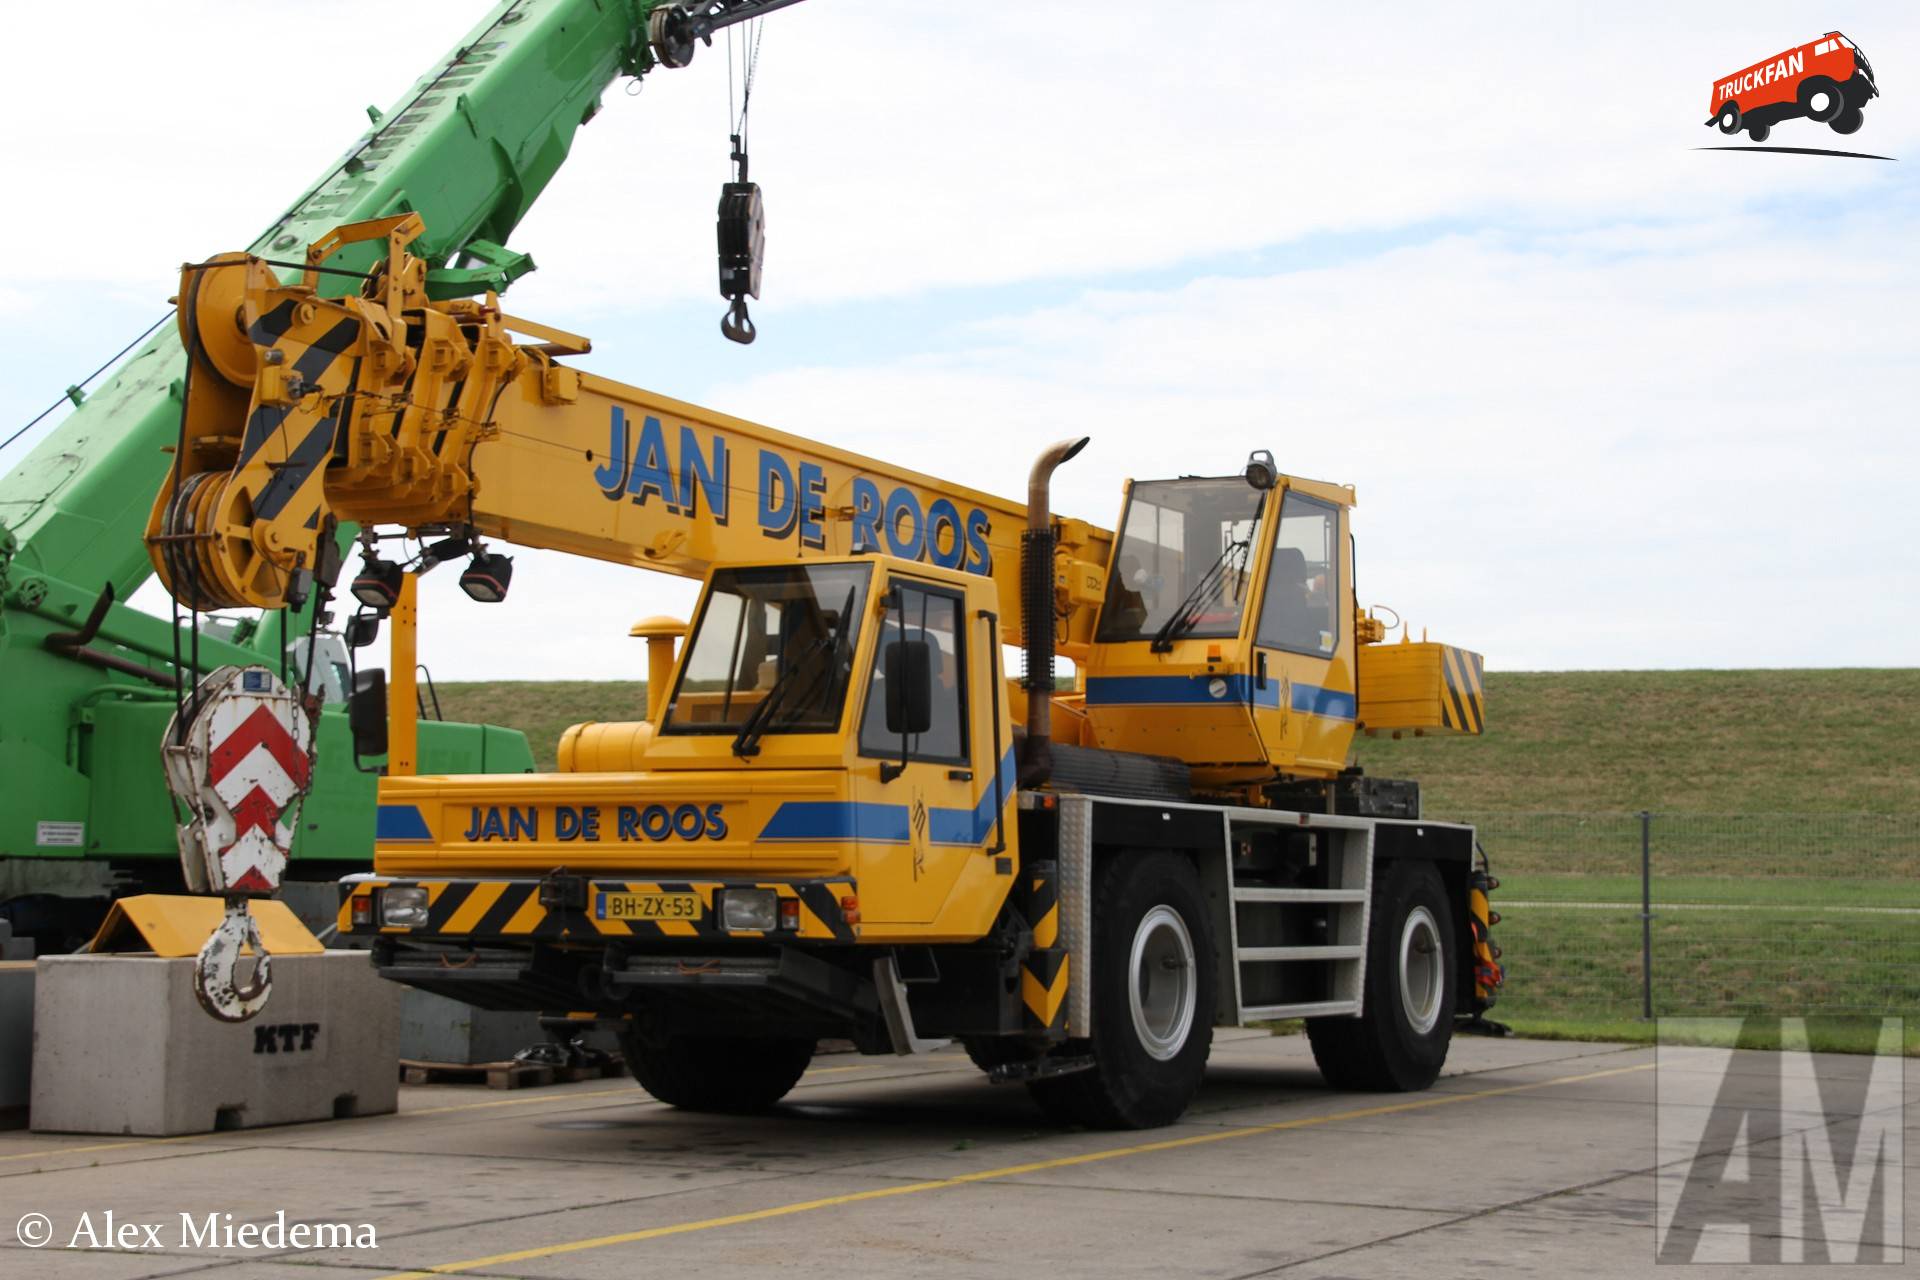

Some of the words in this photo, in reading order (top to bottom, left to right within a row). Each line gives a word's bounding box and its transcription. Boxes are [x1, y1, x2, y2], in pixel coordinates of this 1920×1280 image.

[593, 405, 730, 527] JAN
[757, 448, 827, 552] DE
[850, 476, 993, 577] ROOS
[463, 806, 539, 842] JAN
[555, 806, 600, 842] DE
[617, 803, 729, 842] ROOS
[612, 896, 695, 916] BH-ZX-53
[253, 1022, 320, 1055] KTF
